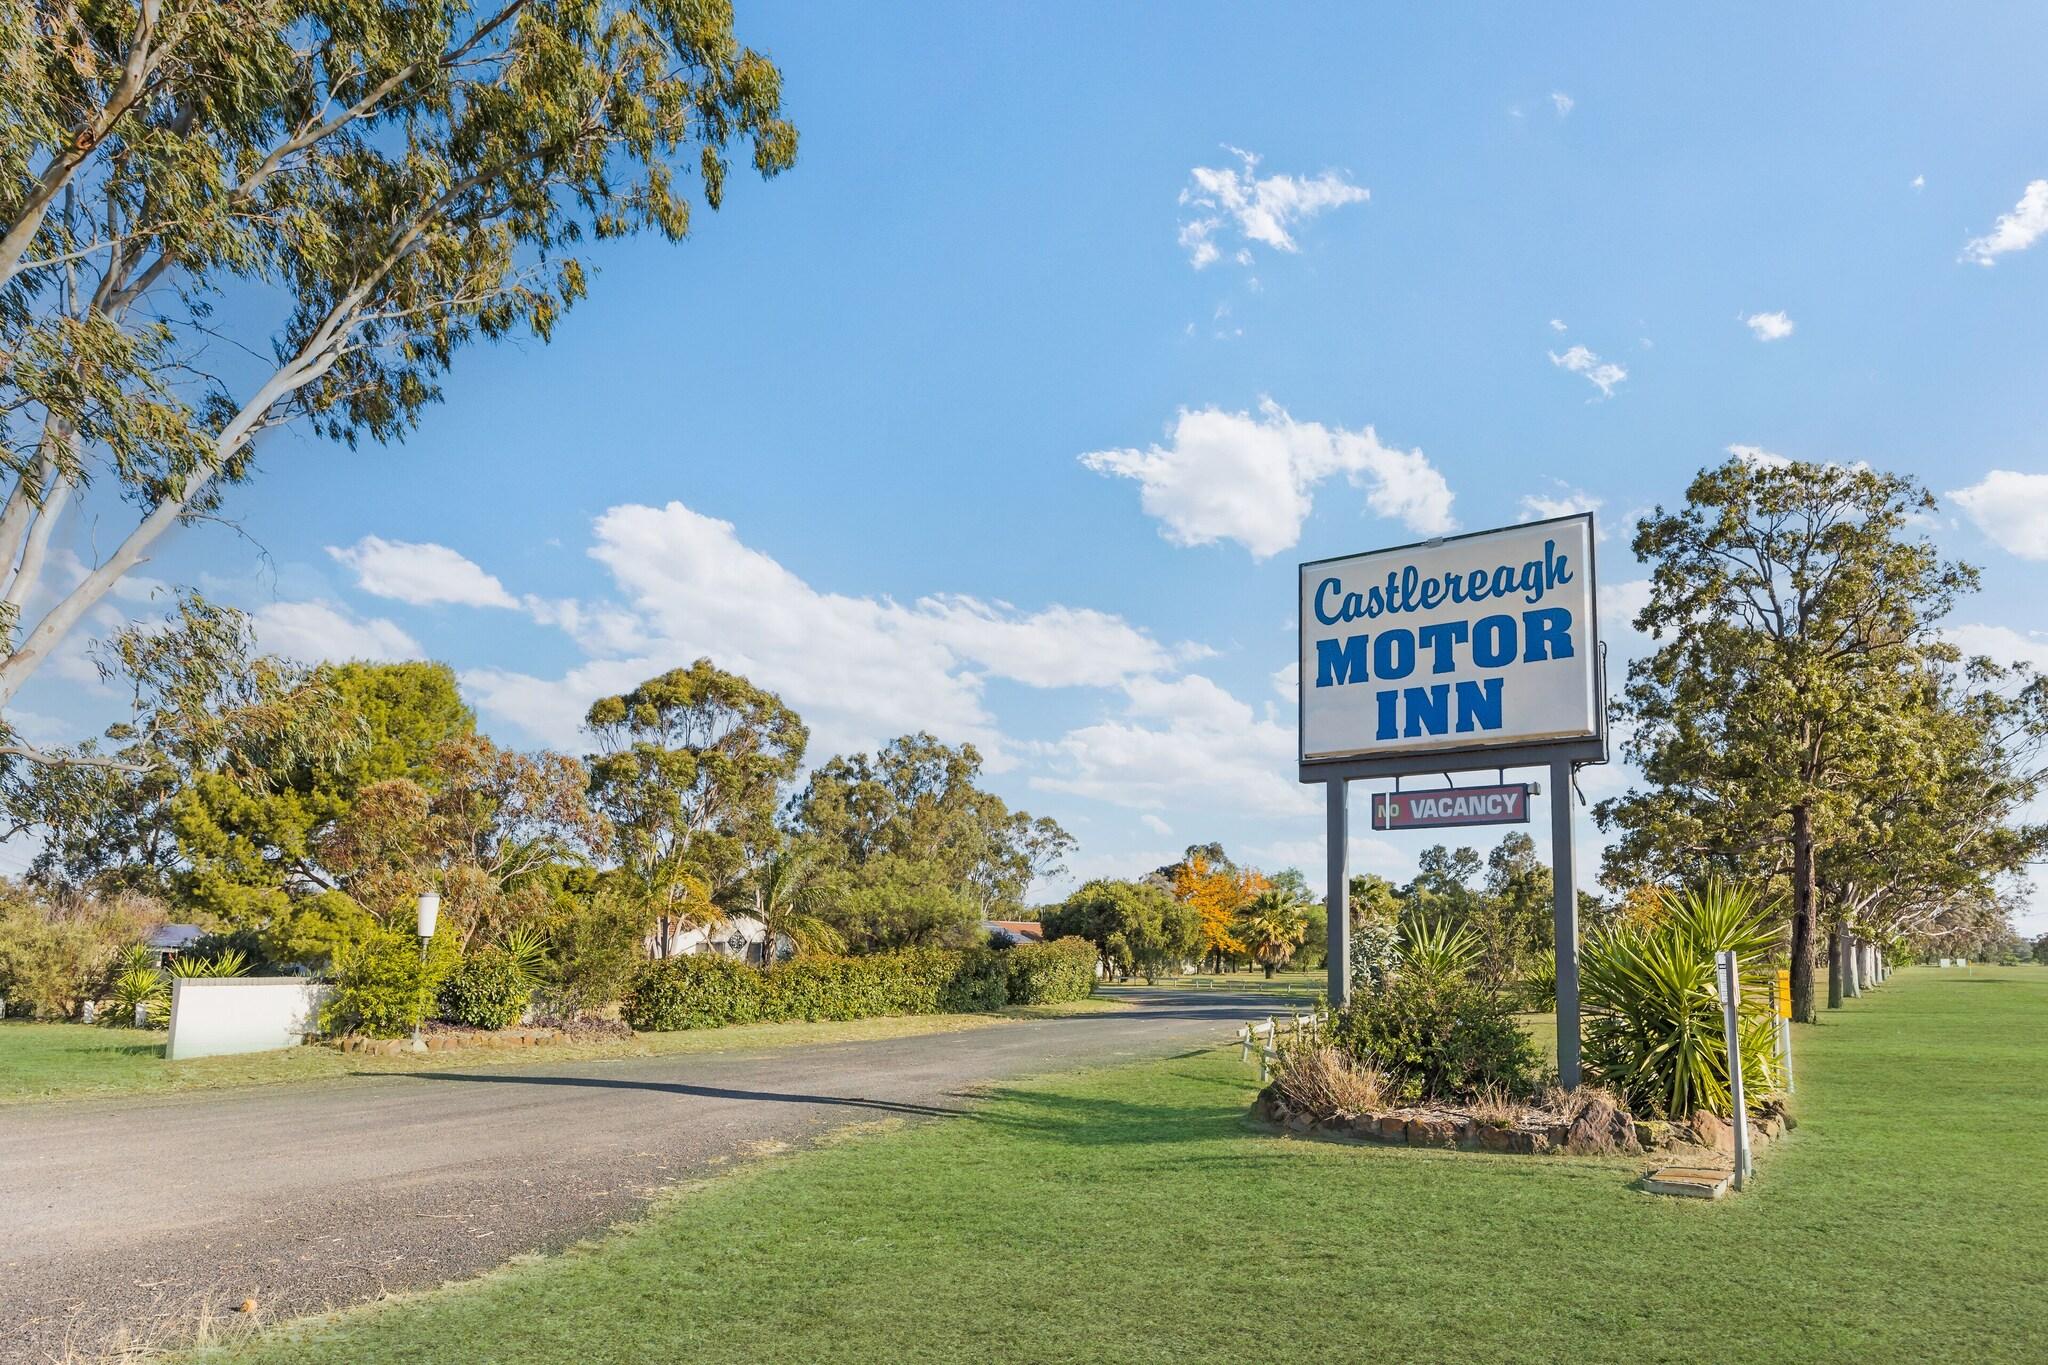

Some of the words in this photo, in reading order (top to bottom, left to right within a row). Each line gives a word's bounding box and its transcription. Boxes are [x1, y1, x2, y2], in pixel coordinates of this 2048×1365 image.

[1315, 540, 1573, 625] Castlereagh
[1316, 607, 1574, 688] MOTOR
[1376, 678, 1504, 741] INN
[1378, 804, 1400, 818] NO
[1410, 793, 1518, 819] VACANCY
